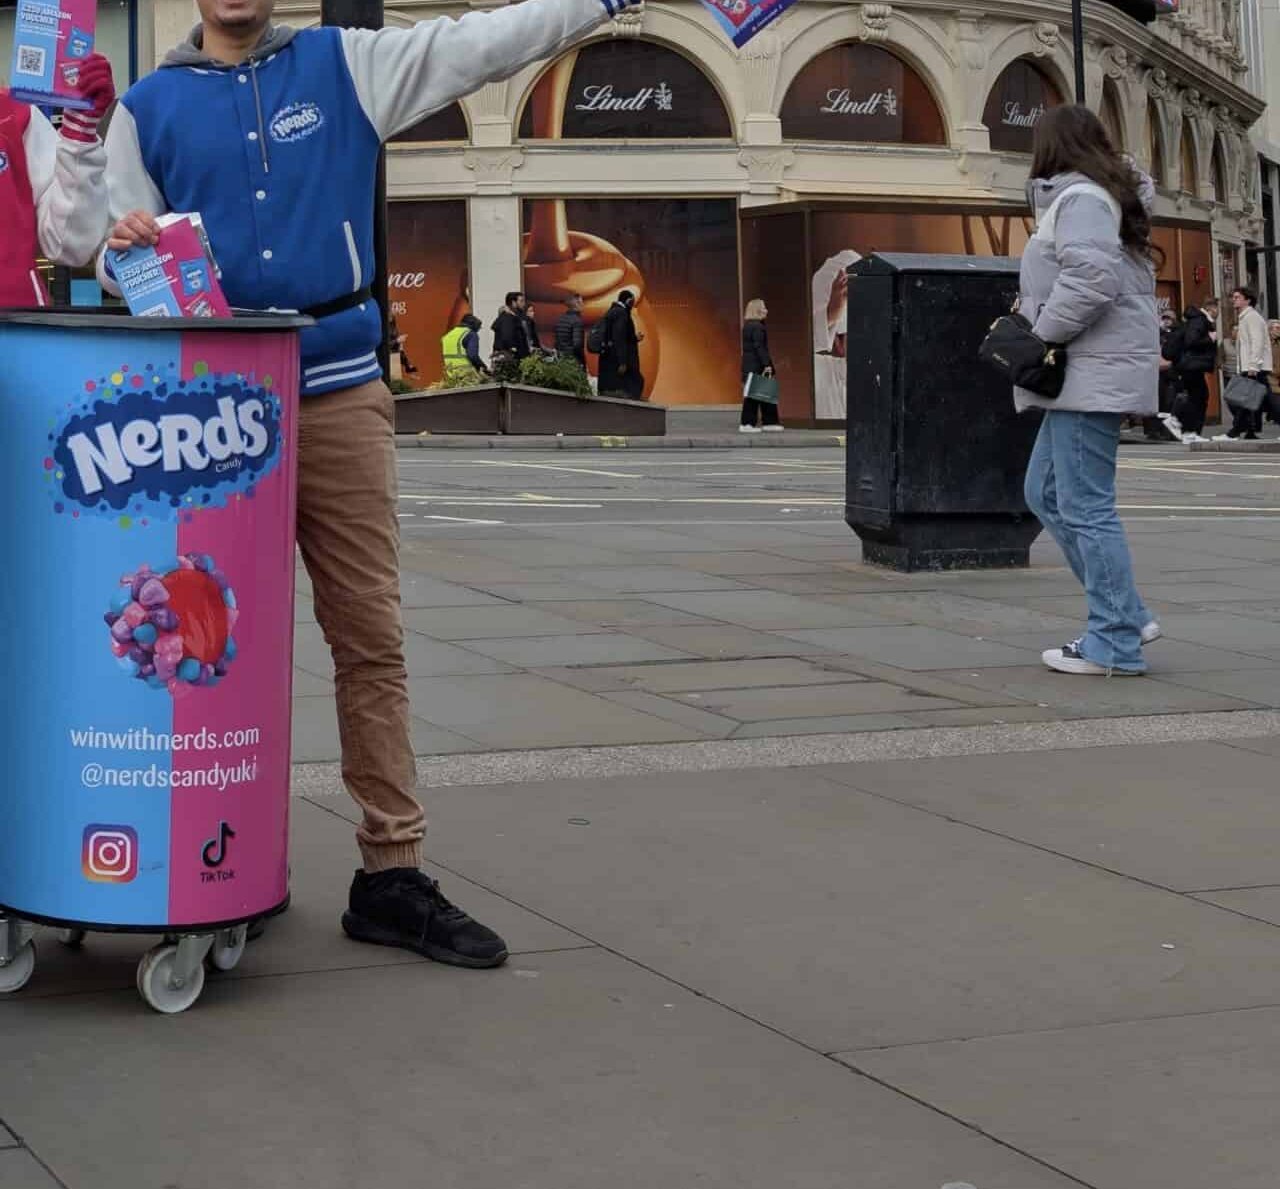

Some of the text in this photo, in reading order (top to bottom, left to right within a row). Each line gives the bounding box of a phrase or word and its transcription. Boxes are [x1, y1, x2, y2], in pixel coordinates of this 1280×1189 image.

[574, 84, 656, 111] Lindt
[821, 87, 884, 115] Lindt
[214, 457, 243, 473] Candy
[70, 726, 260, 751] winwithnerds.com
[81, 756, 257, 791] @nerdscandyuki
[200, 869, 235, 884] TikTok
